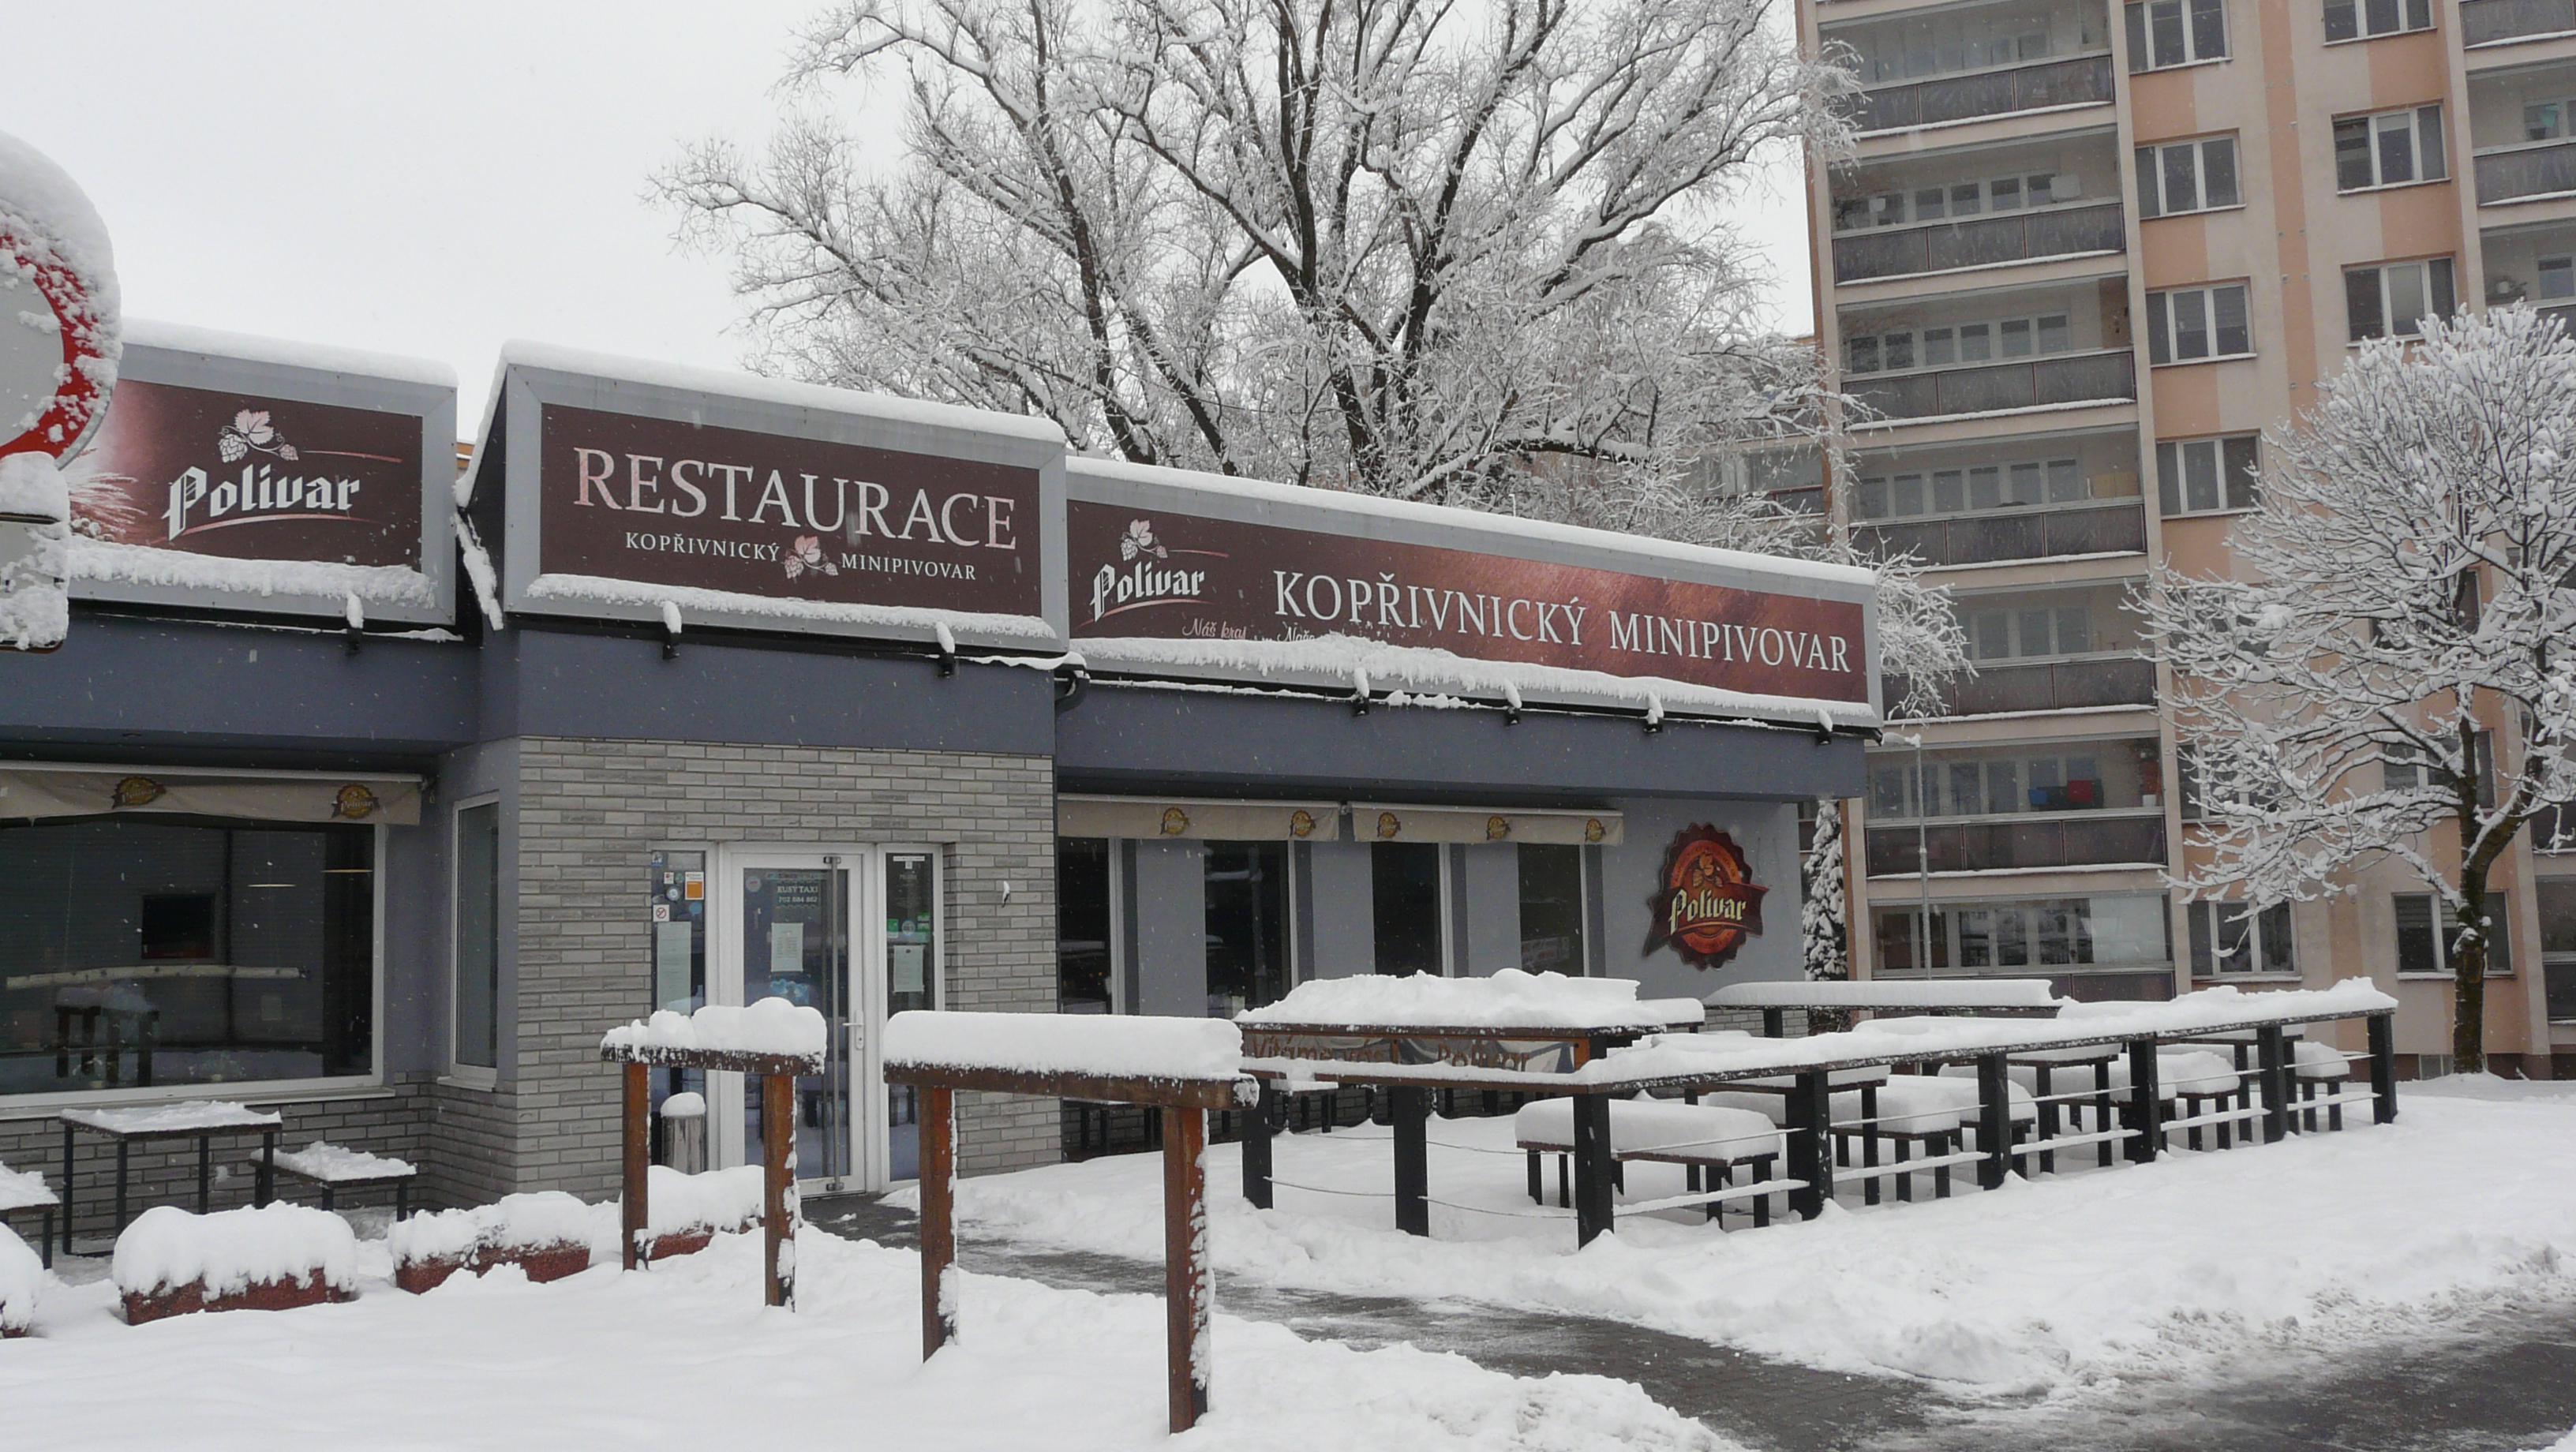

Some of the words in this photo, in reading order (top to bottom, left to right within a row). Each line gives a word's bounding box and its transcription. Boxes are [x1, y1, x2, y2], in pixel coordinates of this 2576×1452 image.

[161, 464, 360, 541] Polivar
[574, 447, 1017, 550] RESTAURACE
[626, 531, 780, 562] KOPŘIVNICKÝ
[841, 552, 976, 581] MINIPIVOVAR
[1089, 561, 1205, 623] Polivar
[1273, 570, 1586, 646] KOPŘIVNICKÝ
[1609, 609, 1852, 673] MINIPIVOVAR
[1668, 889, 1747, 935] Polivar
